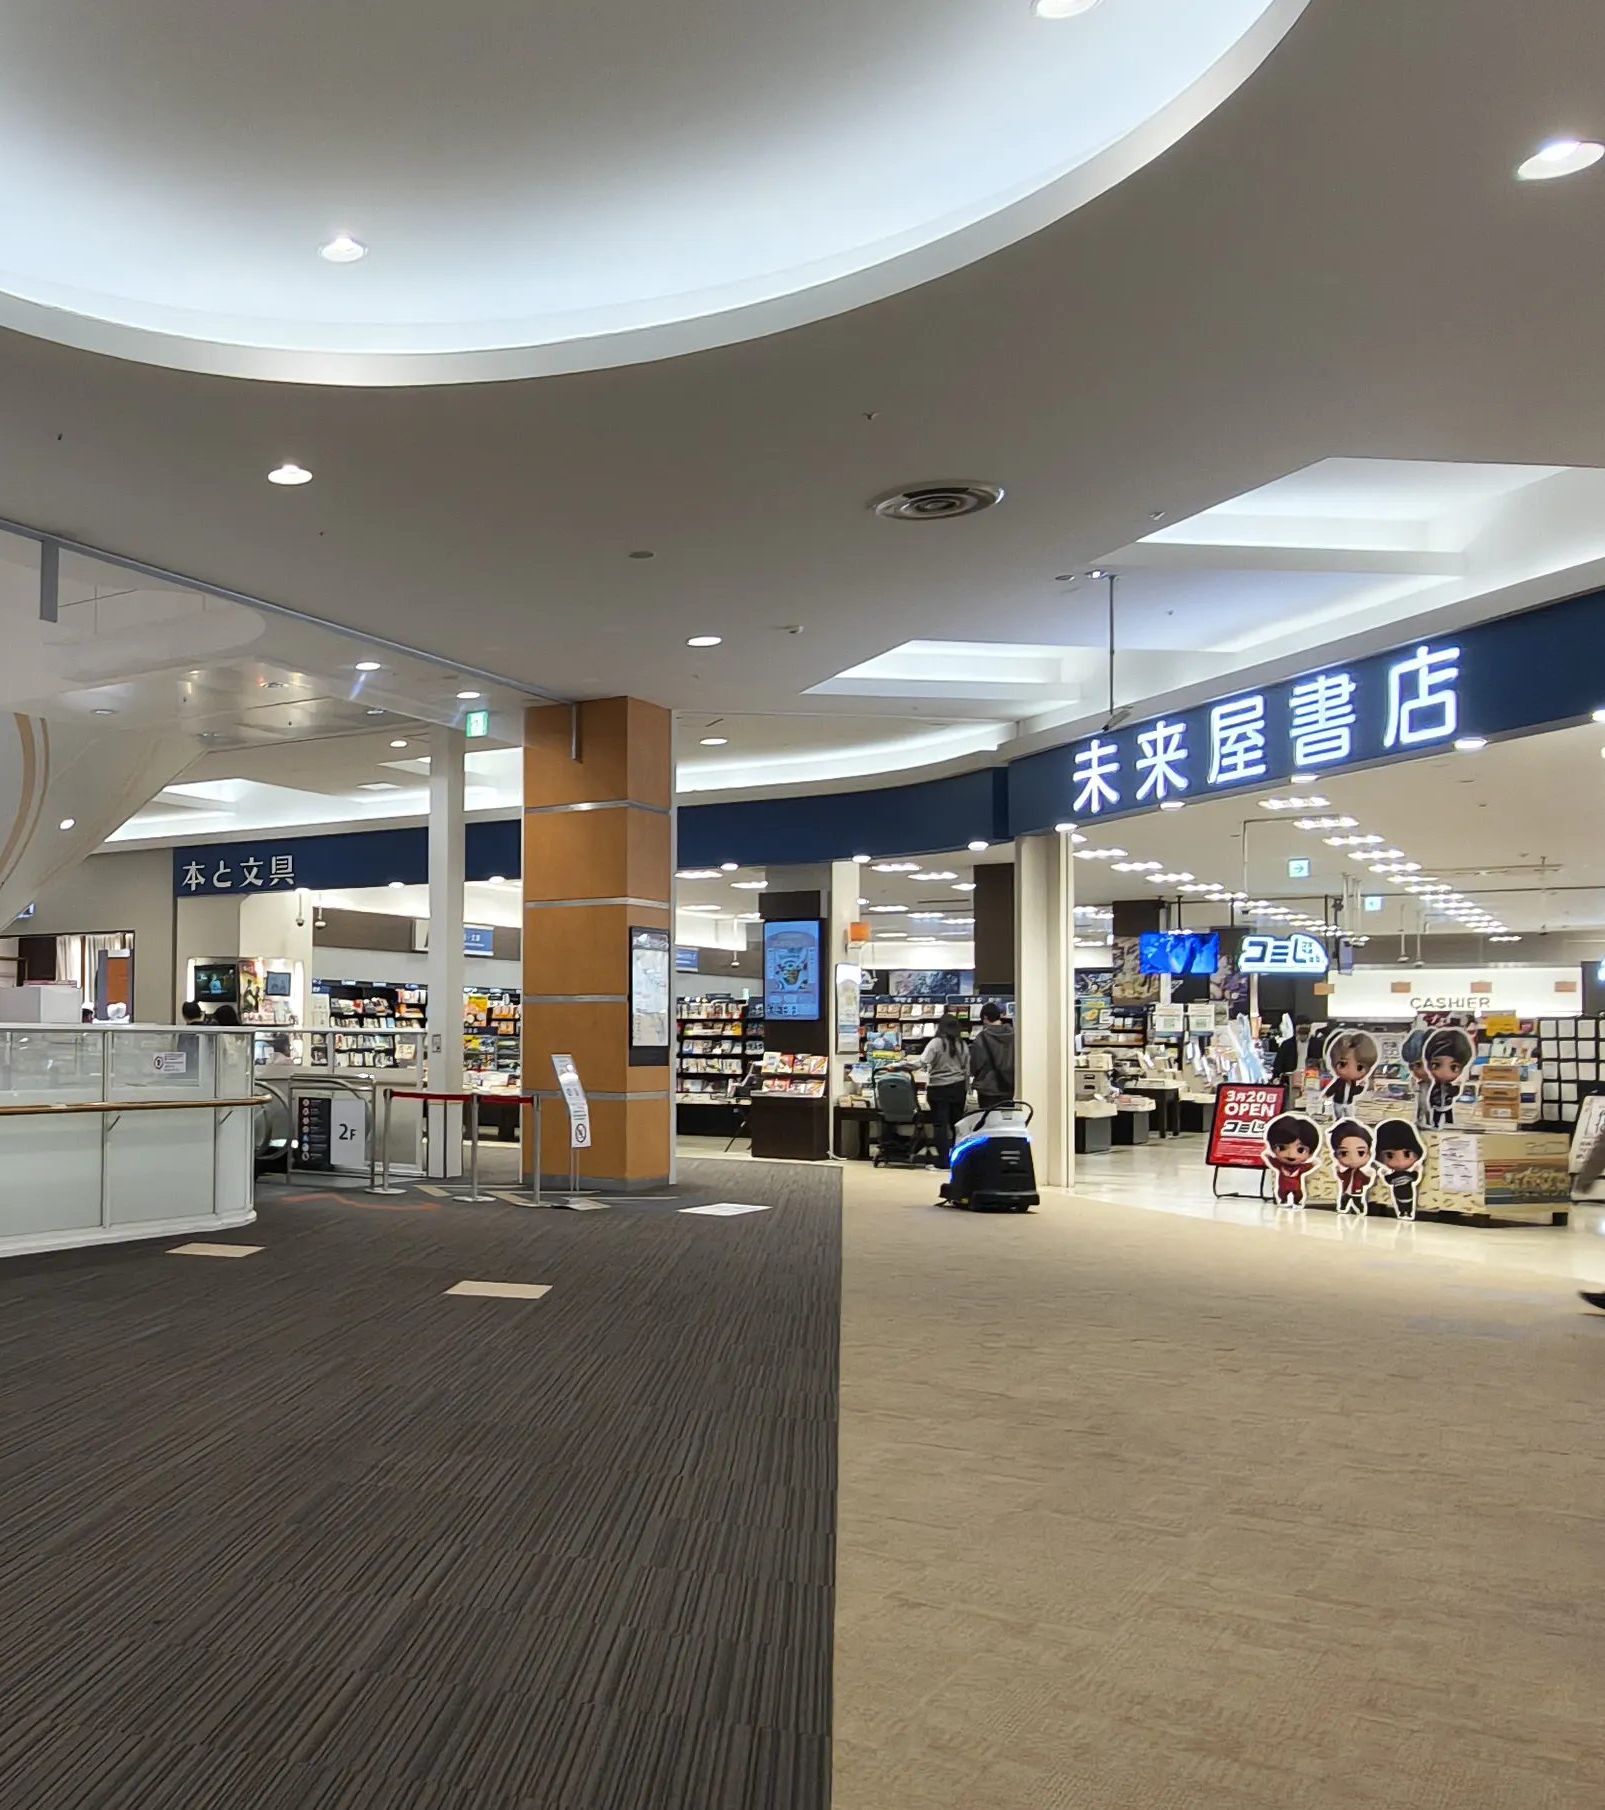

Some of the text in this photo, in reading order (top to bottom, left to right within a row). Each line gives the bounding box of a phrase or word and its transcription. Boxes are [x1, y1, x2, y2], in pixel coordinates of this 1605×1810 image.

[1071, 644, 1462, 815] 未来屋書店
[181, 855, 295, 892] 本と文具
[1409, 996, 1491, 1010] CASHIER
[1224, 1089, 1278, 1104] 3月20日
[1224, 1102, 1276, 1118] OPEN
[338, 1123, 357, 1141] 2F
